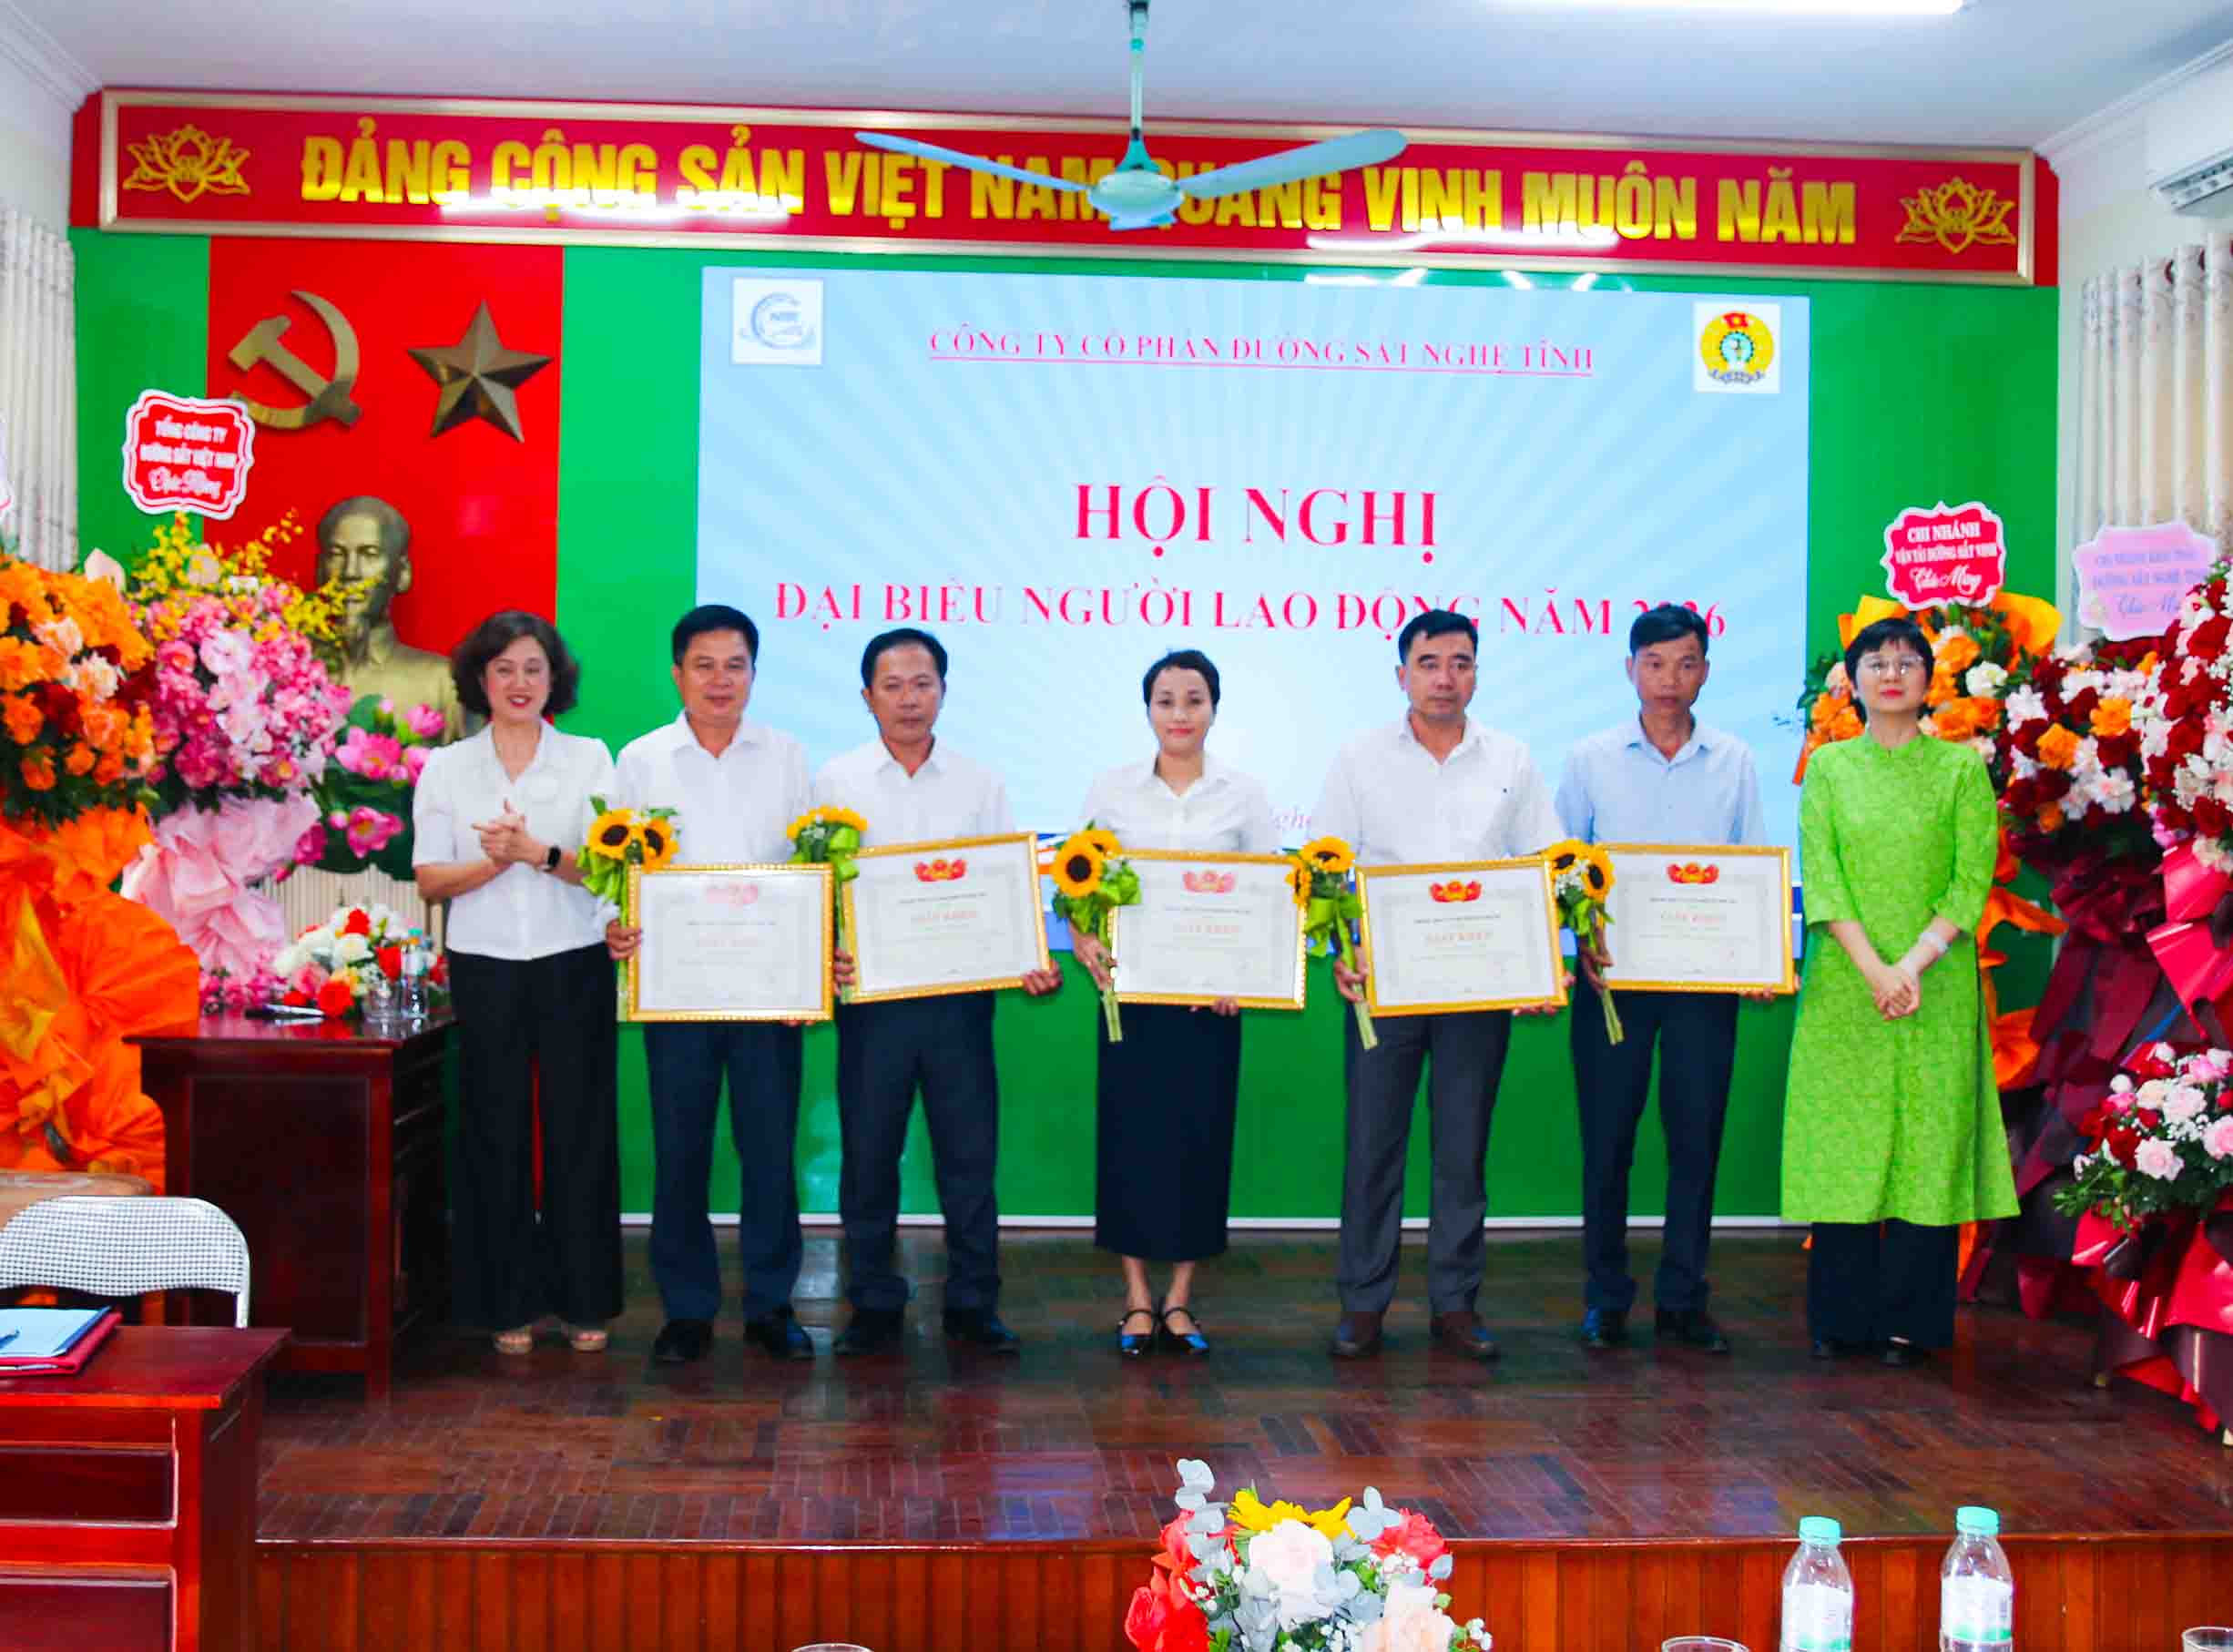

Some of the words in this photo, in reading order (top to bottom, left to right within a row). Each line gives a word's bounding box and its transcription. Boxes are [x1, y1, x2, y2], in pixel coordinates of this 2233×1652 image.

[301, 117, 469, 206] ĐẢNG
[490, 128, 658, 221] CỘNG
[677, 125, 804, 215] SẢN
[1363, 167, 1503, 234] VINH
[1522, 159, 1698, 241] MUÔN
[1717, 166, 1857, 244] NĂM
[931, 321, 1021, 355] CÔNG
[1035, 333, 1067, 355] TY
[1072, 474, 1217, 558] HỘI
[1243, 487, 1443, 563] NGHỊ
[775, 582, 862, 630] ĐẠI
[1021, 576, 1195, 627] NGƯỜI
[1212, 590, 1320, 629] LAO
[1499, 587, 1613, 636] NĂM
